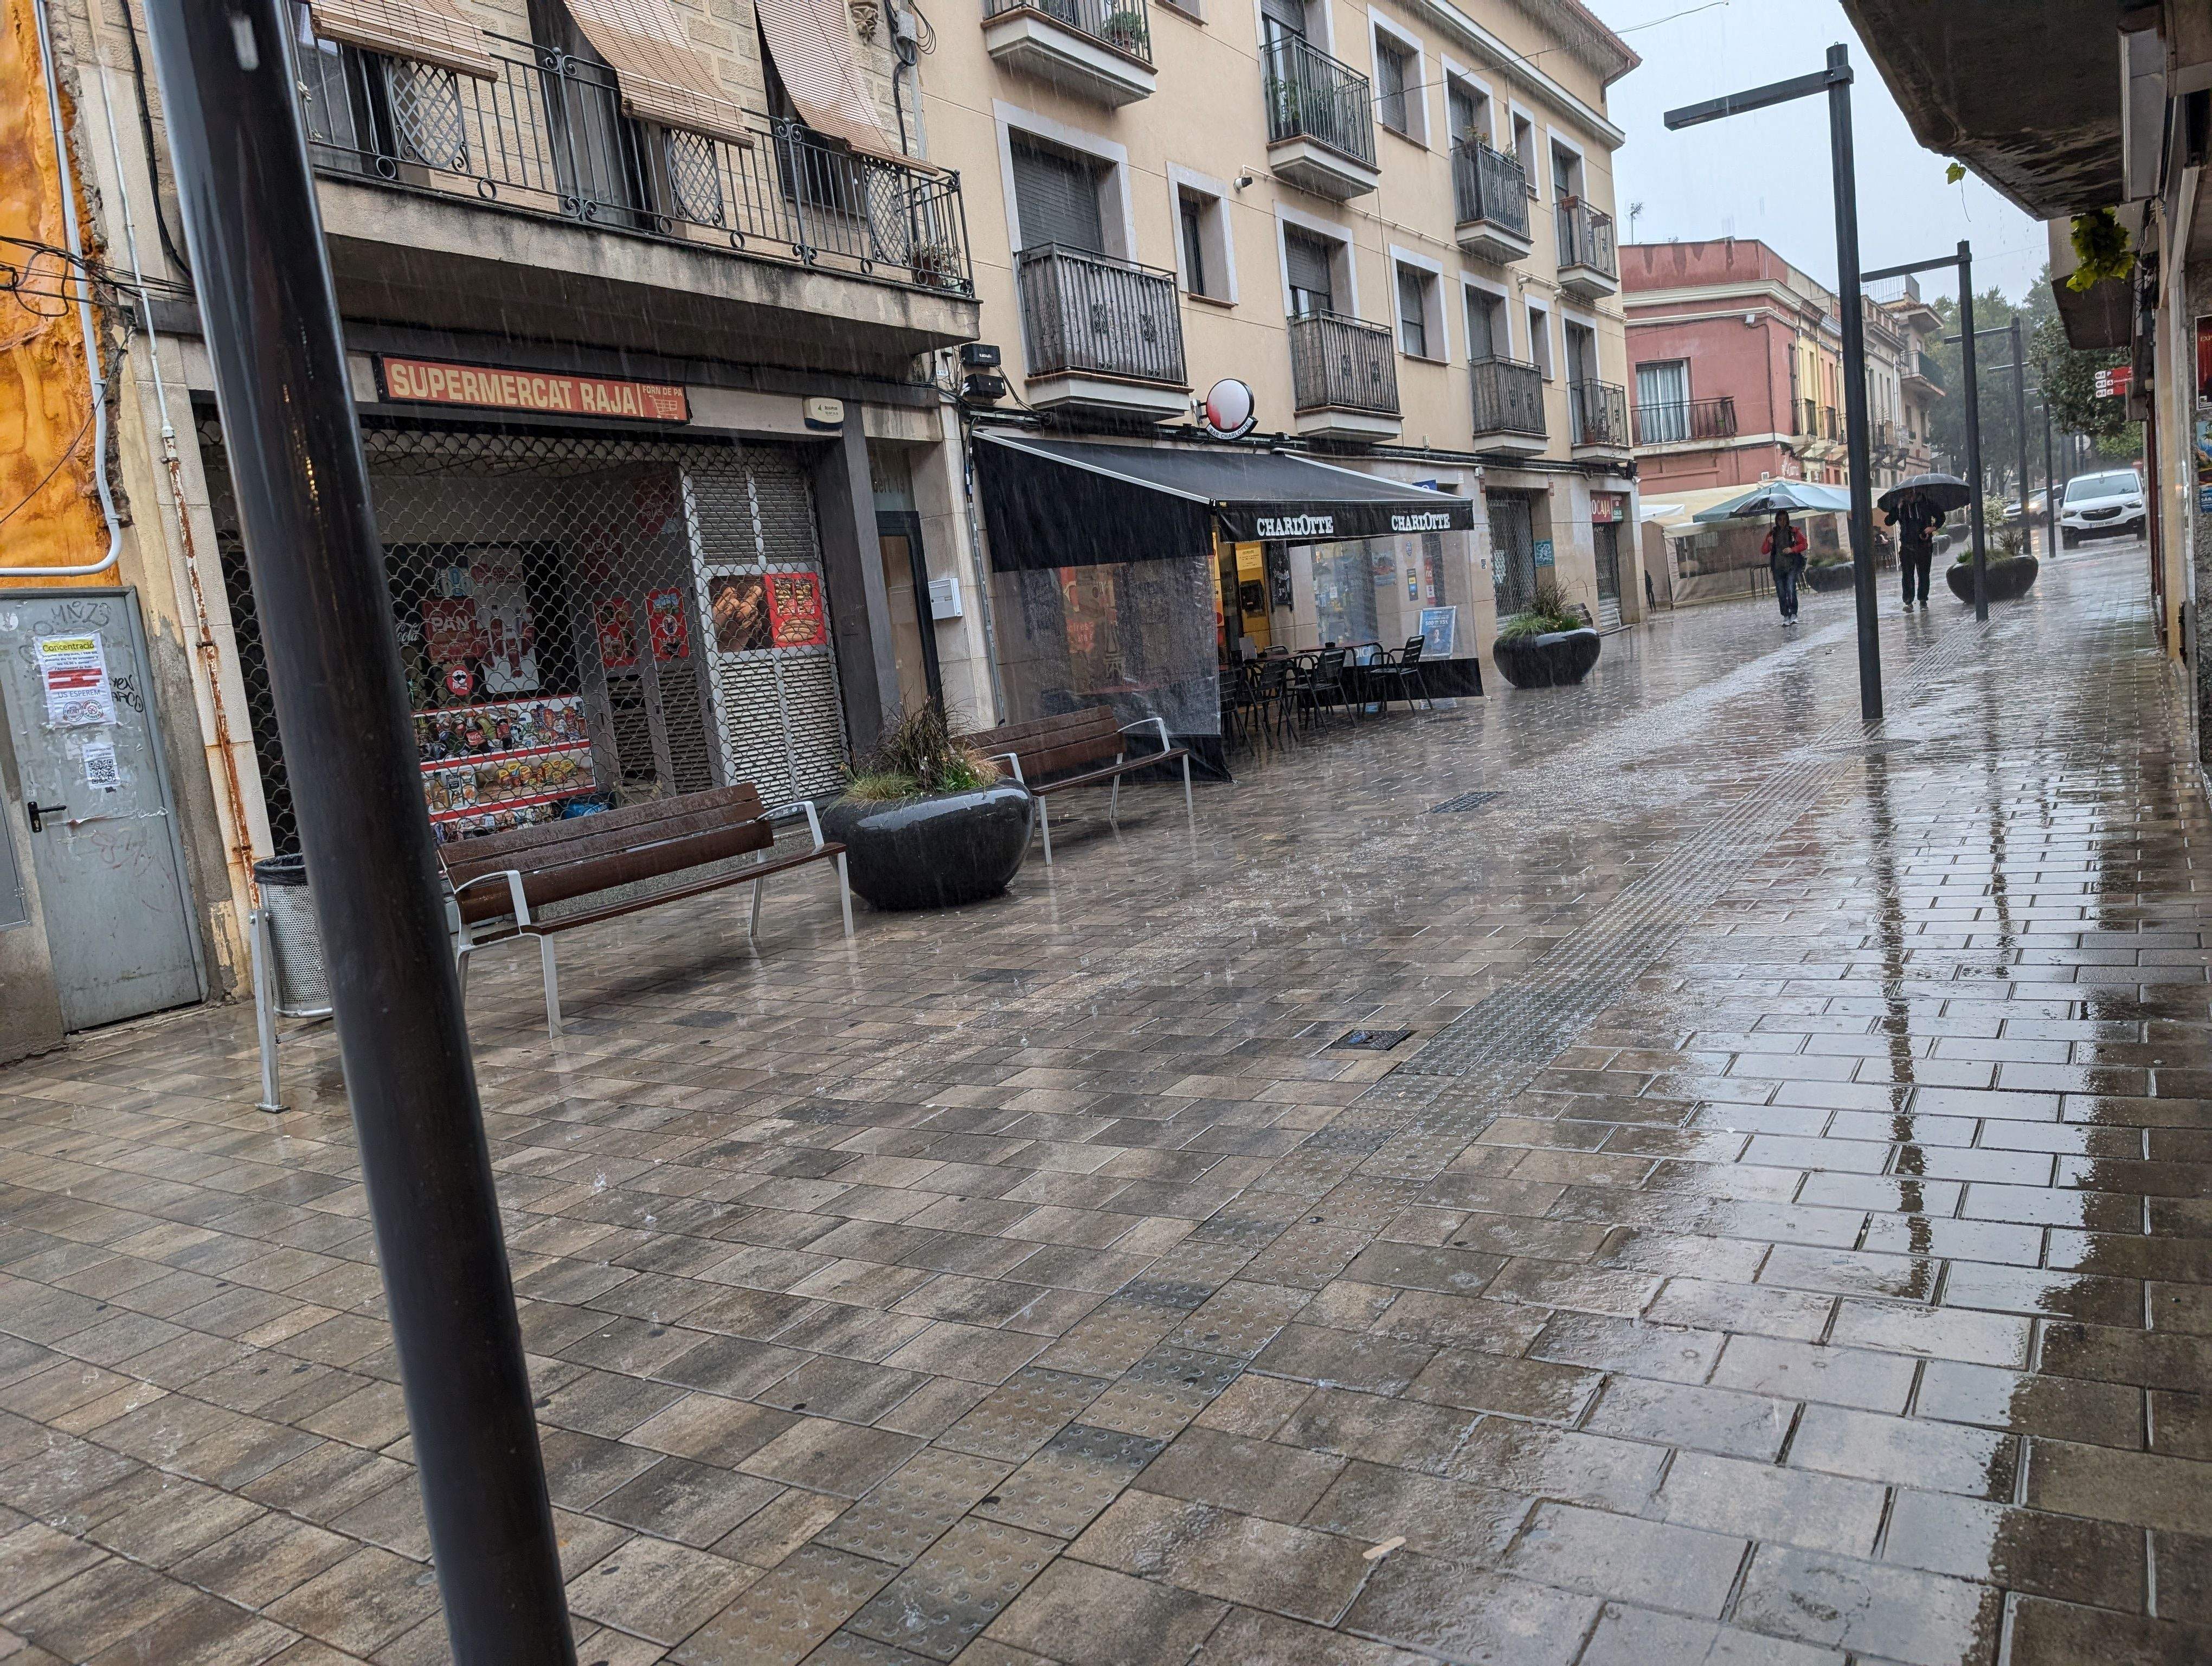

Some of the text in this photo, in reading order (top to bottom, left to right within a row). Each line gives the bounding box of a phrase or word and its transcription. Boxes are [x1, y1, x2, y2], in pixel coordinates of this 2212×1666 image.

[391, 364, 637, 414] SUPERMERCAT RAJA
[642, 385, 683, 397] FORN DE PA
[1209, 423, 1250, 438] BAR CHARLOTTE
[1257, 514, 1334, 536] CHARLOTTE
[1391, 511, 1450, 531] CHARLOTTE
[431, 616, 470, 632] PAN
[43, 641, 94, 652] Concentració
[69, 689, 101, 697] ESPEREM
